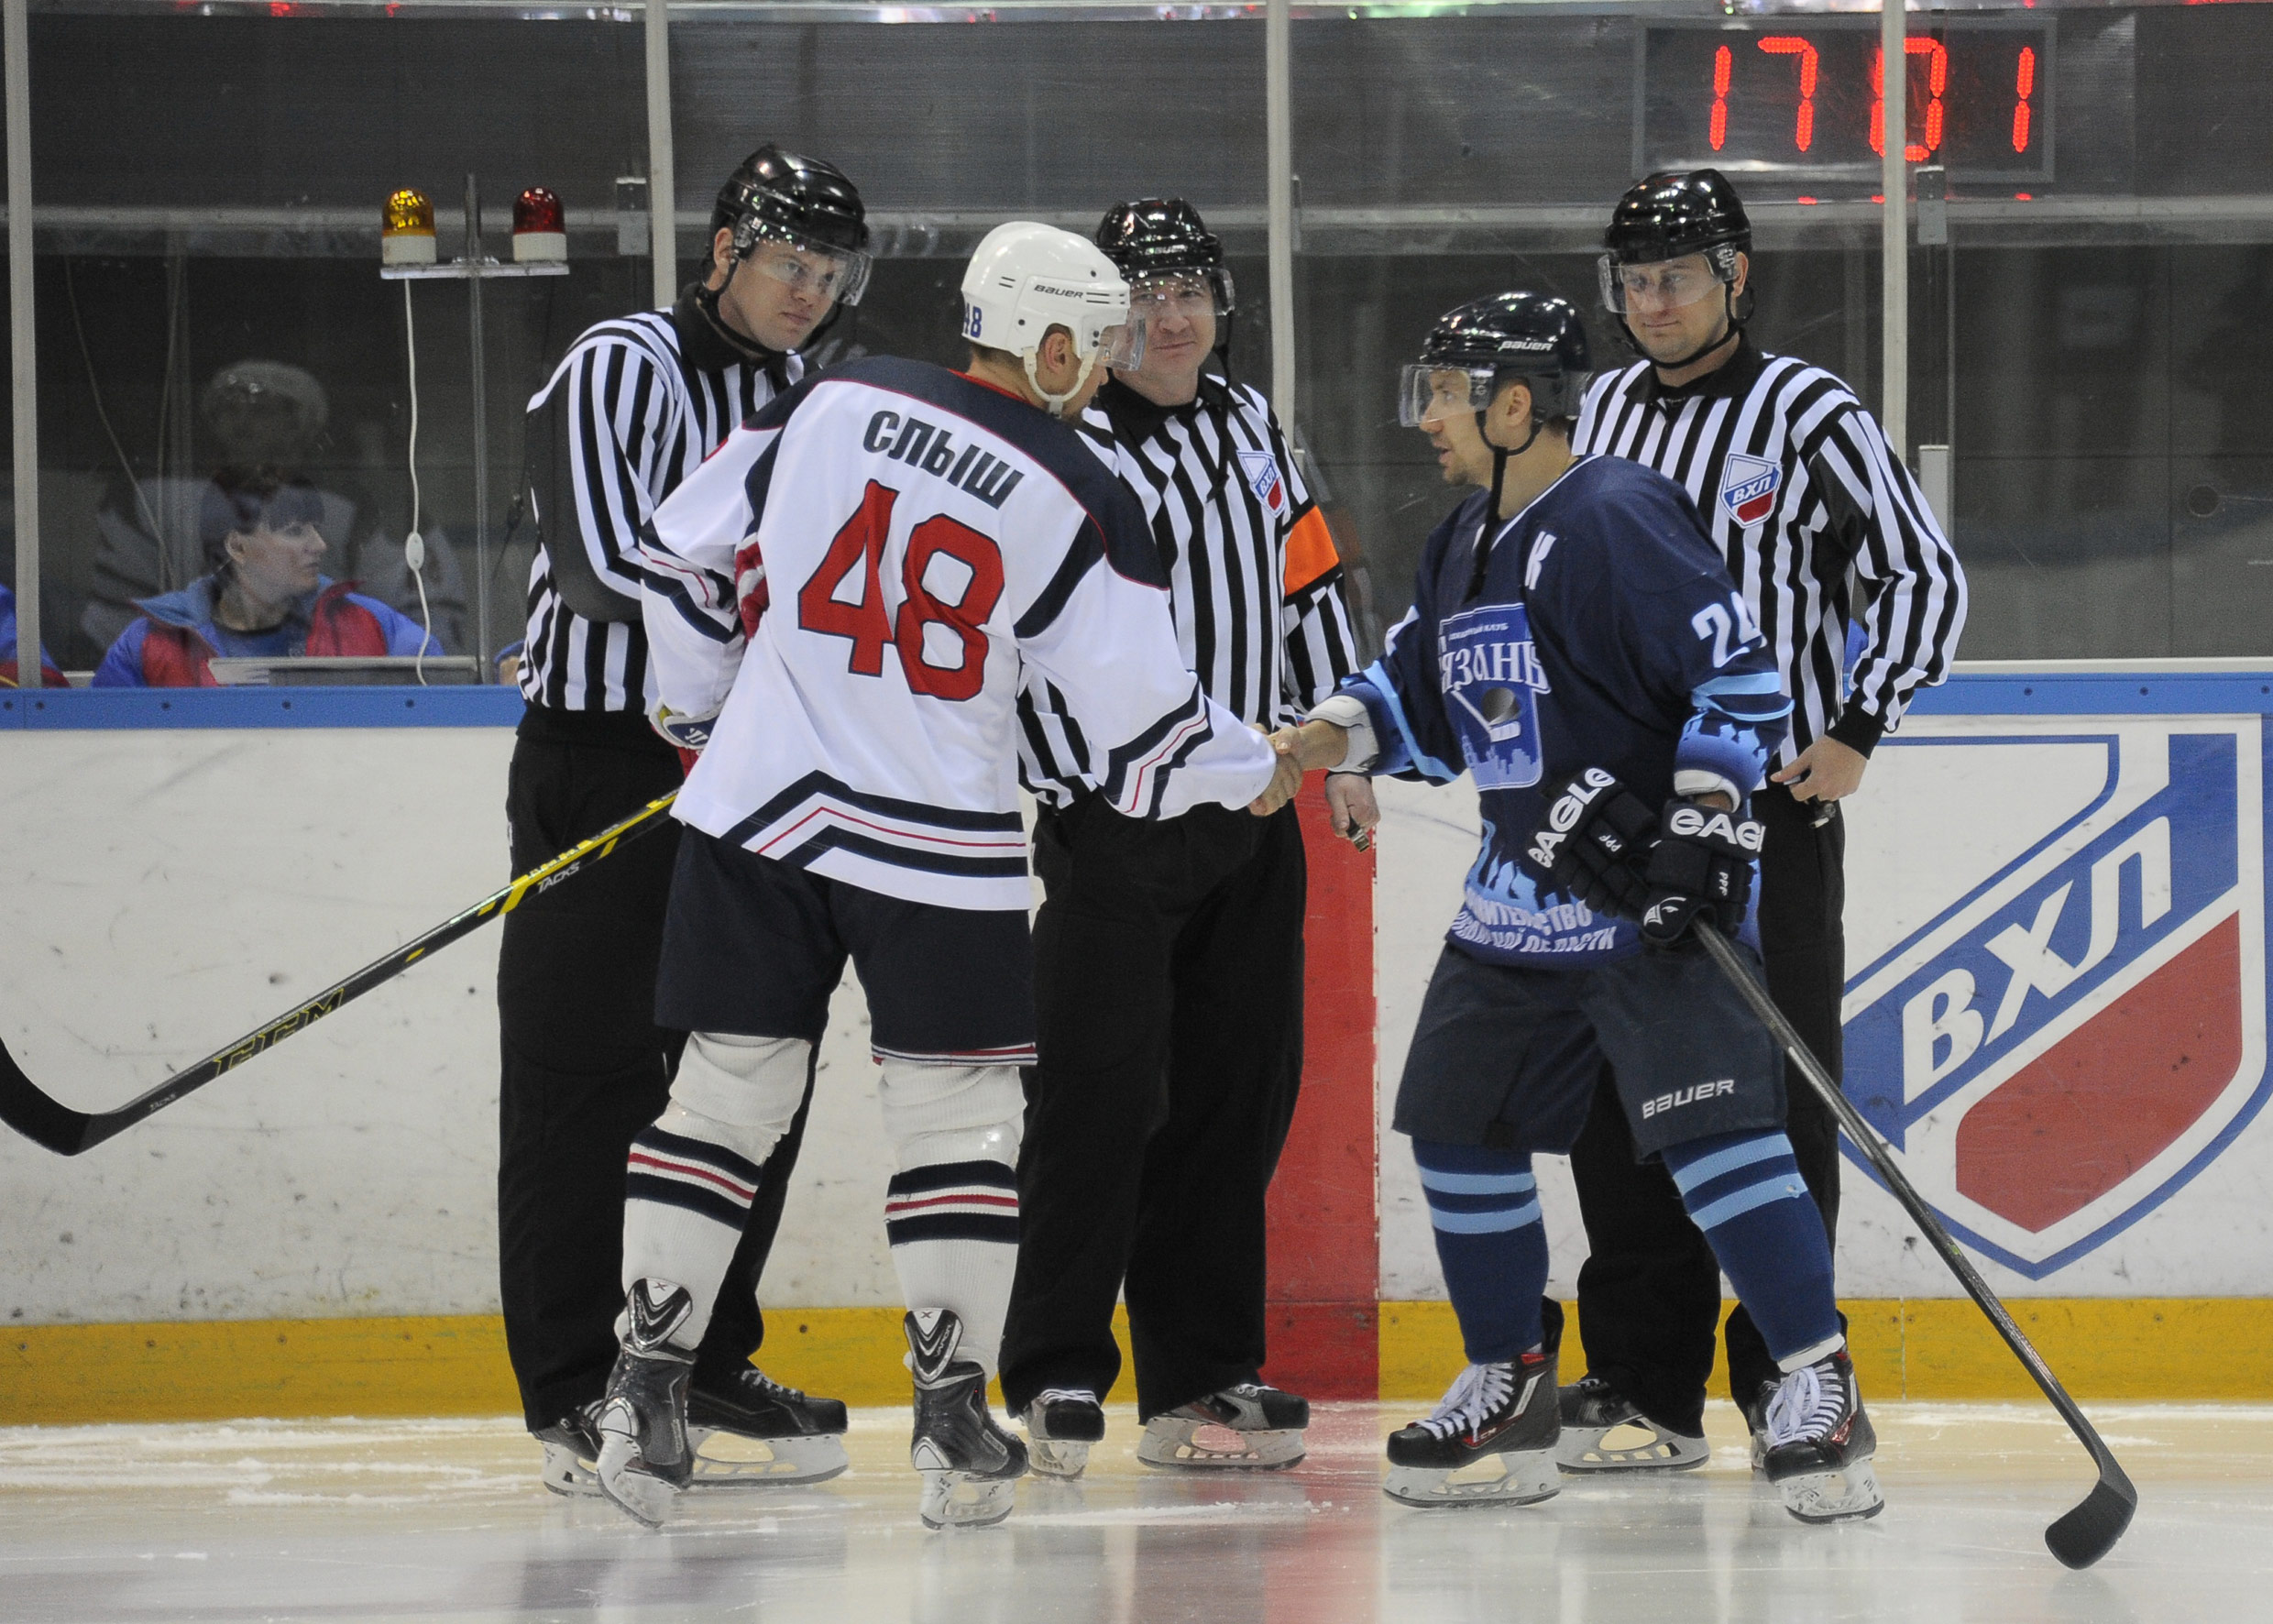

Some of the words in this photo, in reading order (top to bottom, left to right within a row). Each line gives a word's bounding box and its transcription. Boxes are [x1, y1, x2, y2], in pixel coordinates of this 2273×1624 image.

[1034, 284, 1084, 299] BAUER
[1500, 341, 1554, 352] BAUER
[862, 410, 1025, 510] СЛЫШ
[1732, 476, 1773, 504] ВХЛ
[797, 478, 1005, 701] 48
[1439, 640, 1551, 694] ЯЗАНЬ
[537, 861, 581, 894] TACKS
[1903, 816, 2171, 1105] ВХЛ
[1642, 1080, 1735, 1119] BAUER
